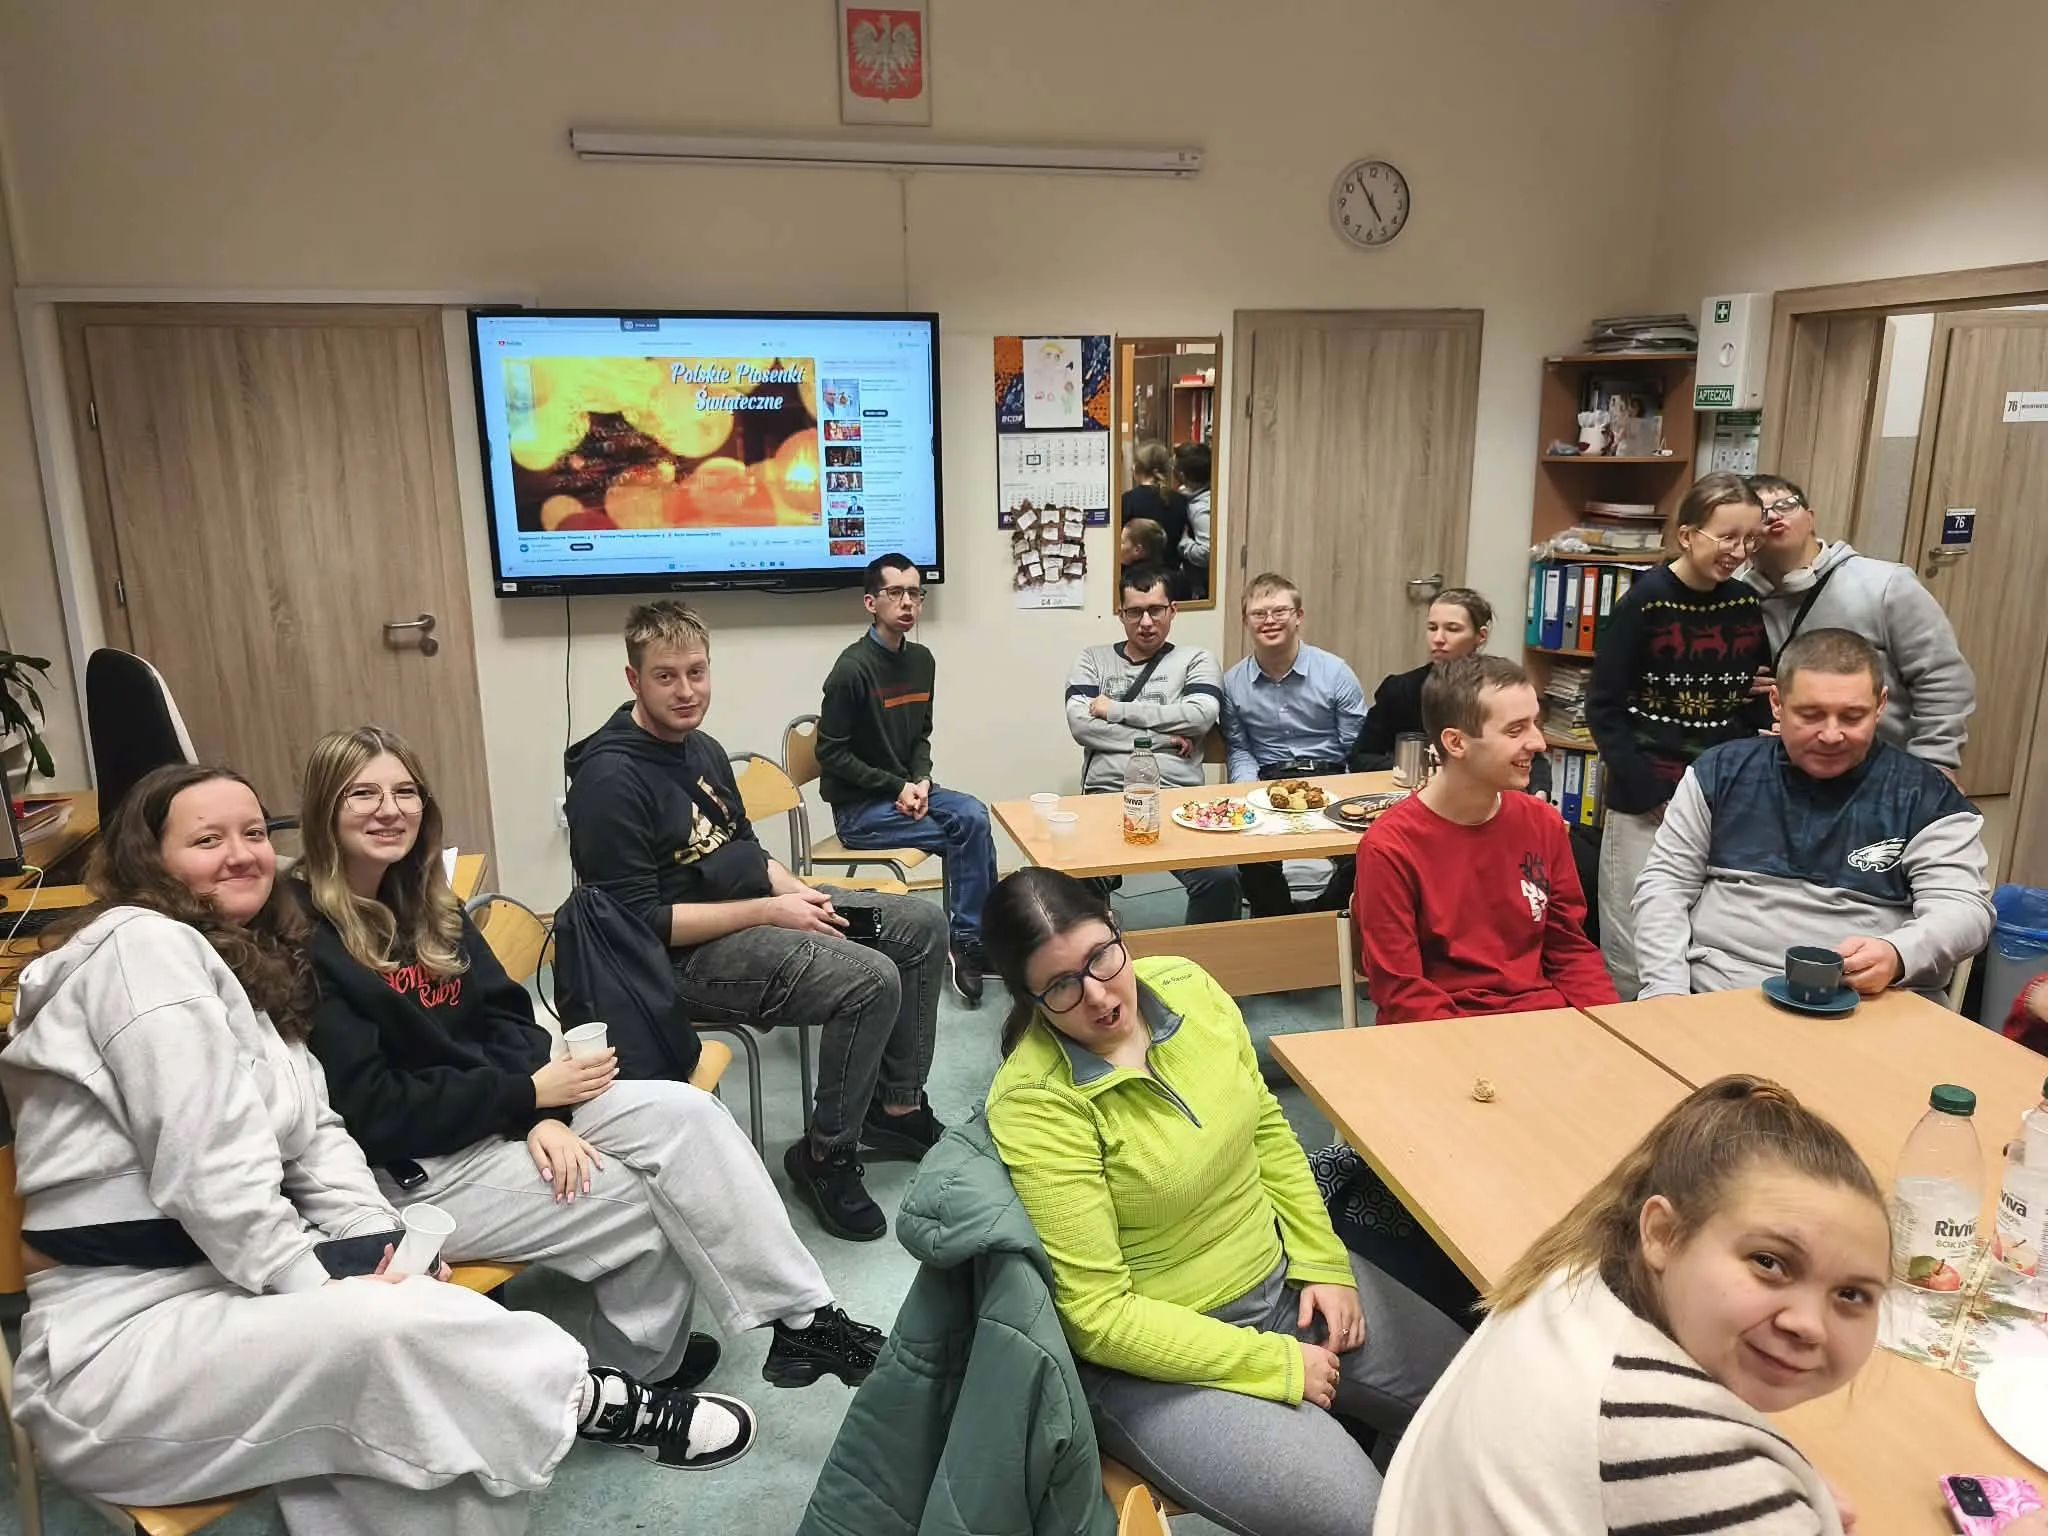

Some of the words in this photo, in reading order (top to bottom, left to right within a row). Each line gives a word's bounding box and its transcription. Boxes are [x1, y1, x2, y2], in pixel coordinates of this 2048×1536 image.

[1393, 183, 1399, 193] 2
[1355, 224, 1362, 235] 7
[1366, 229, 1373, 241] 6
[671, 362, 731, 384] Polskie
[735, 362, 805, 384] Piosenki
[696, 385, 784, 414] Świąteczne
[2007, 400, 2018, 412] 76
[1955, 516, 1966, 529] 76
[1124, 795, 1143, 806] viva
[1999, 1187, 2027, 1217] viva
[1934, 1218, 1977, 1238] Riviv
